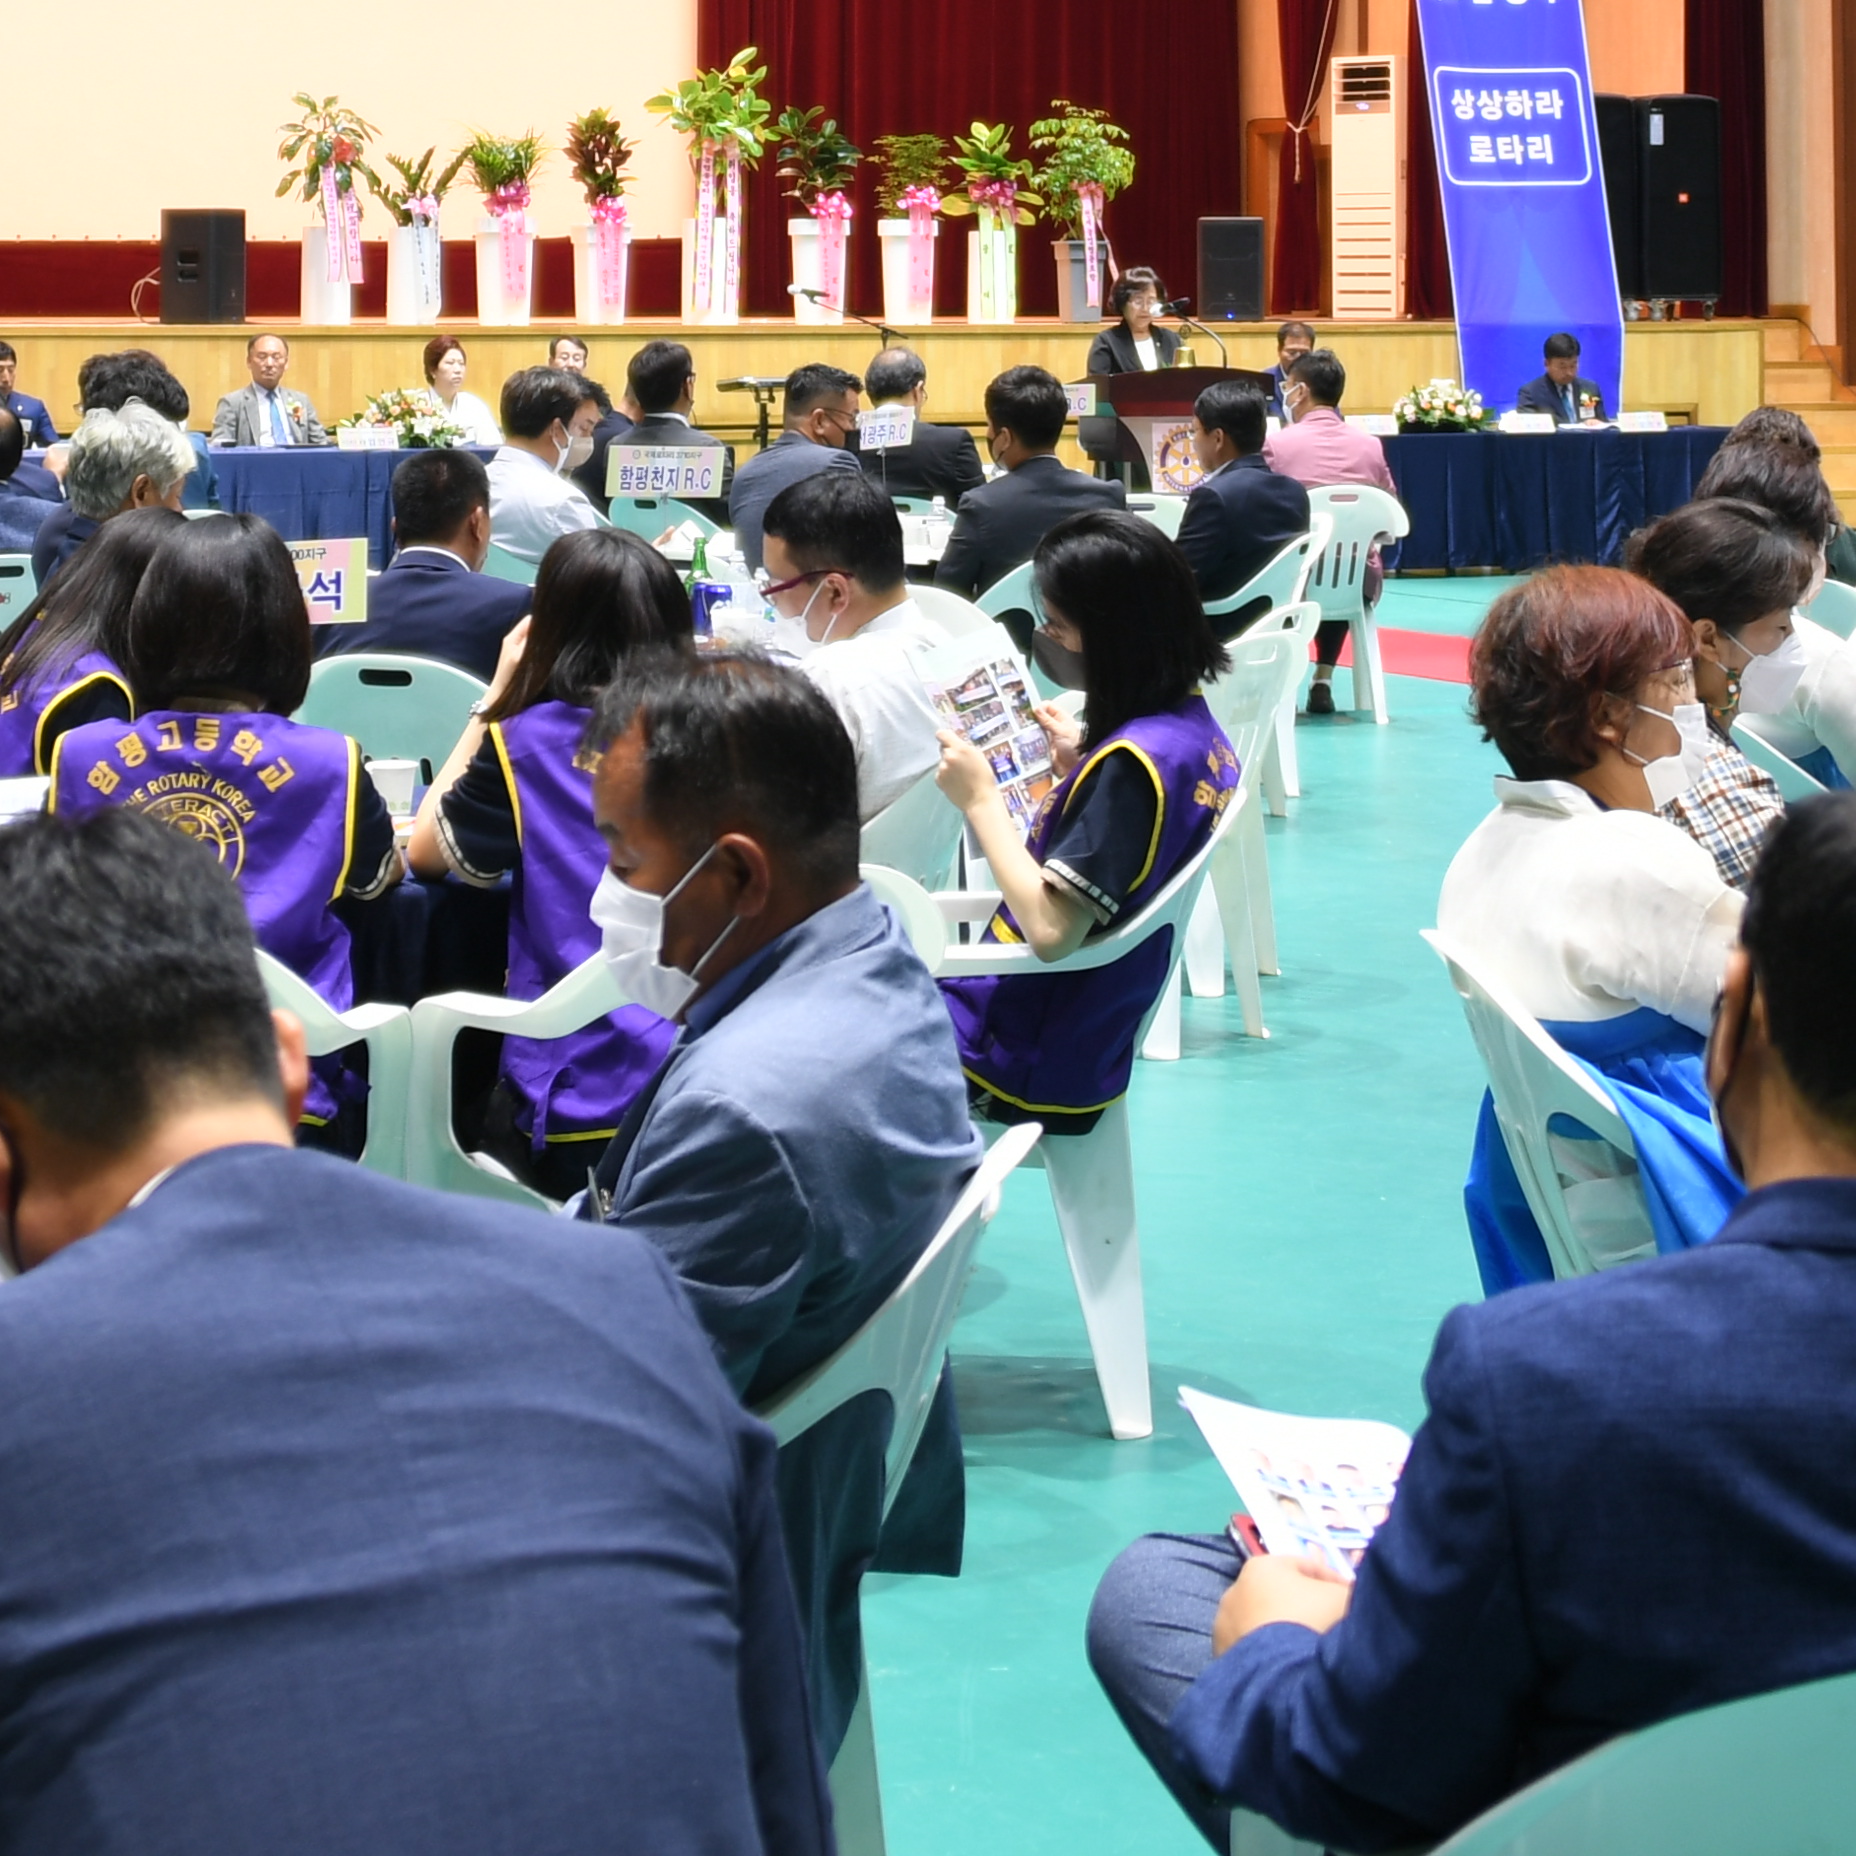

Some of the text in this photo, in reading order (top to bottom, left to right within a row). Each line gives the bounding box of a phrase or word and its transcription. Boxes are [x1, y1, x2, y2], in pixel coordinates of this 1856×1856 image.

[1451, 89, 1564, 120] 상상하라
[1469, 134, 1554, 165] 로타리
[619, 465, 711, 491] 함평천지 R.C
[87, 718, 295, 795] 함평고등학교
[147, 772, 211, 797] ROTARY
[211, 778, 257, 824] KOREA
